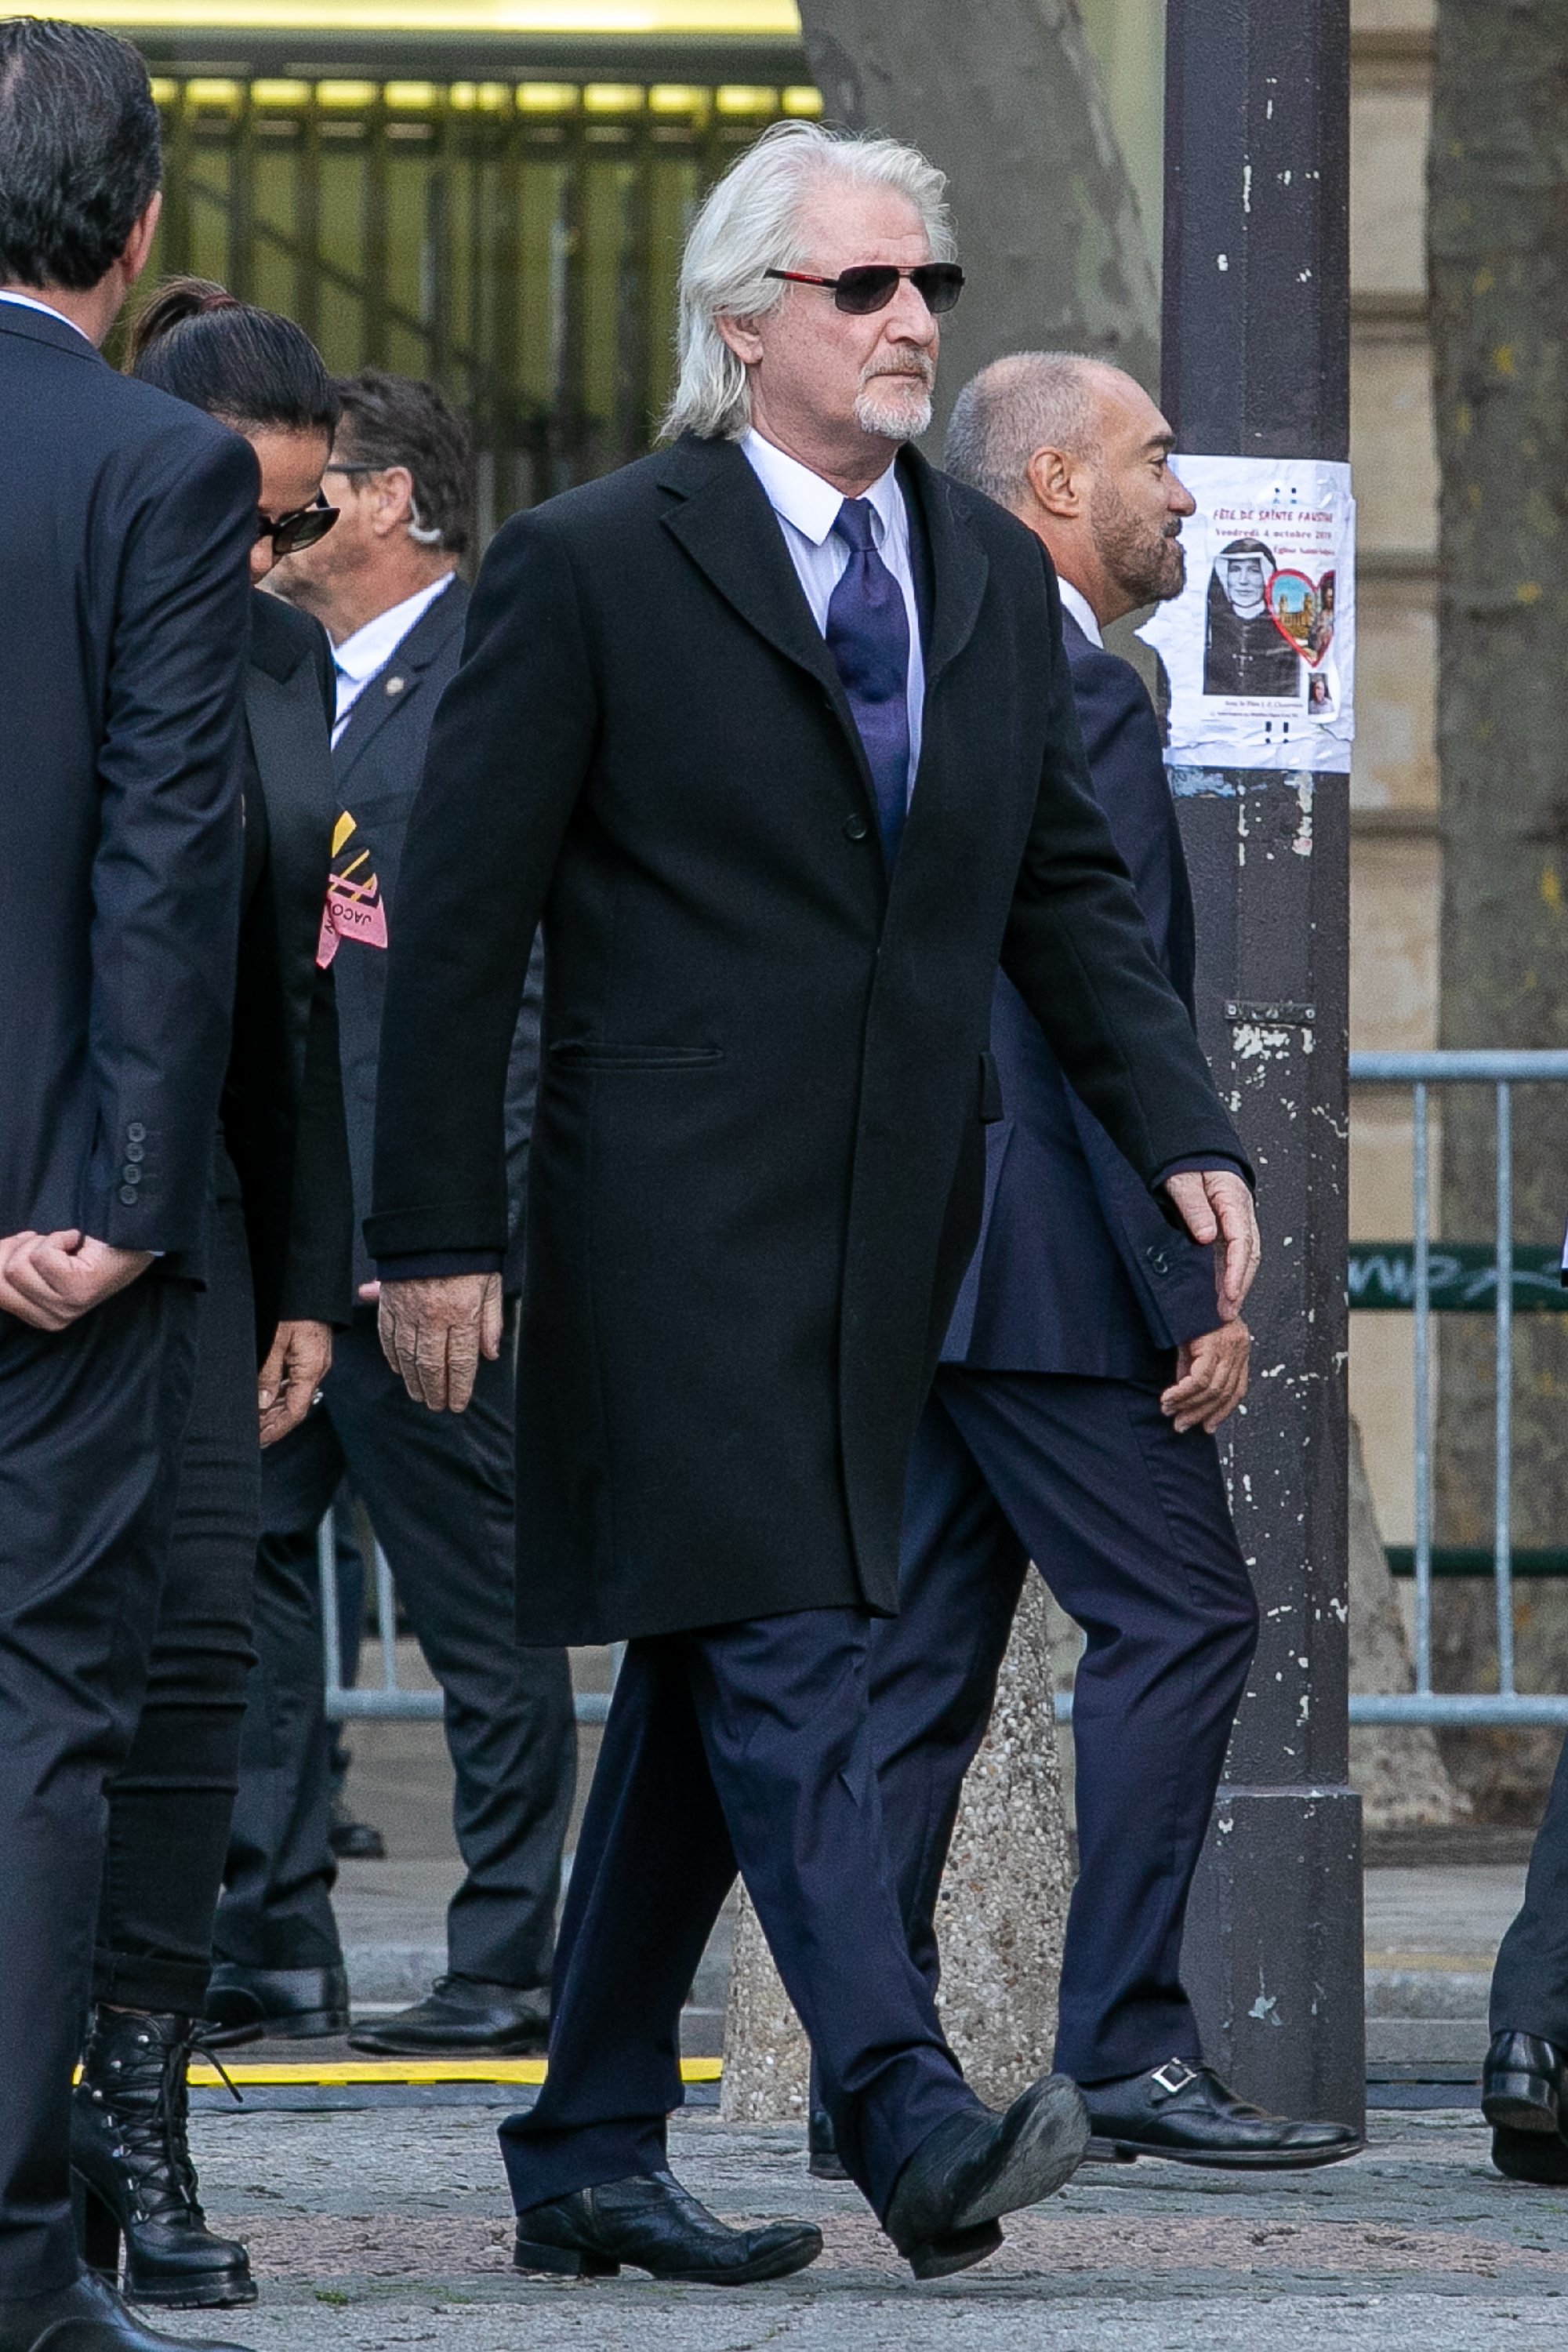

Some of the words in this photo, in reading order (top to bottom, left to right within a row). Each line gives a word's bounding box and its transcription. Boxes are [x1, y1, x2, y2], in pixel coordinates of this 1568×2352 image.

[1240, 510, 1254, 521] DE
[1215, 528, 1260, 537] Vendredi
[1273, 530, 1312, 539] octobre
